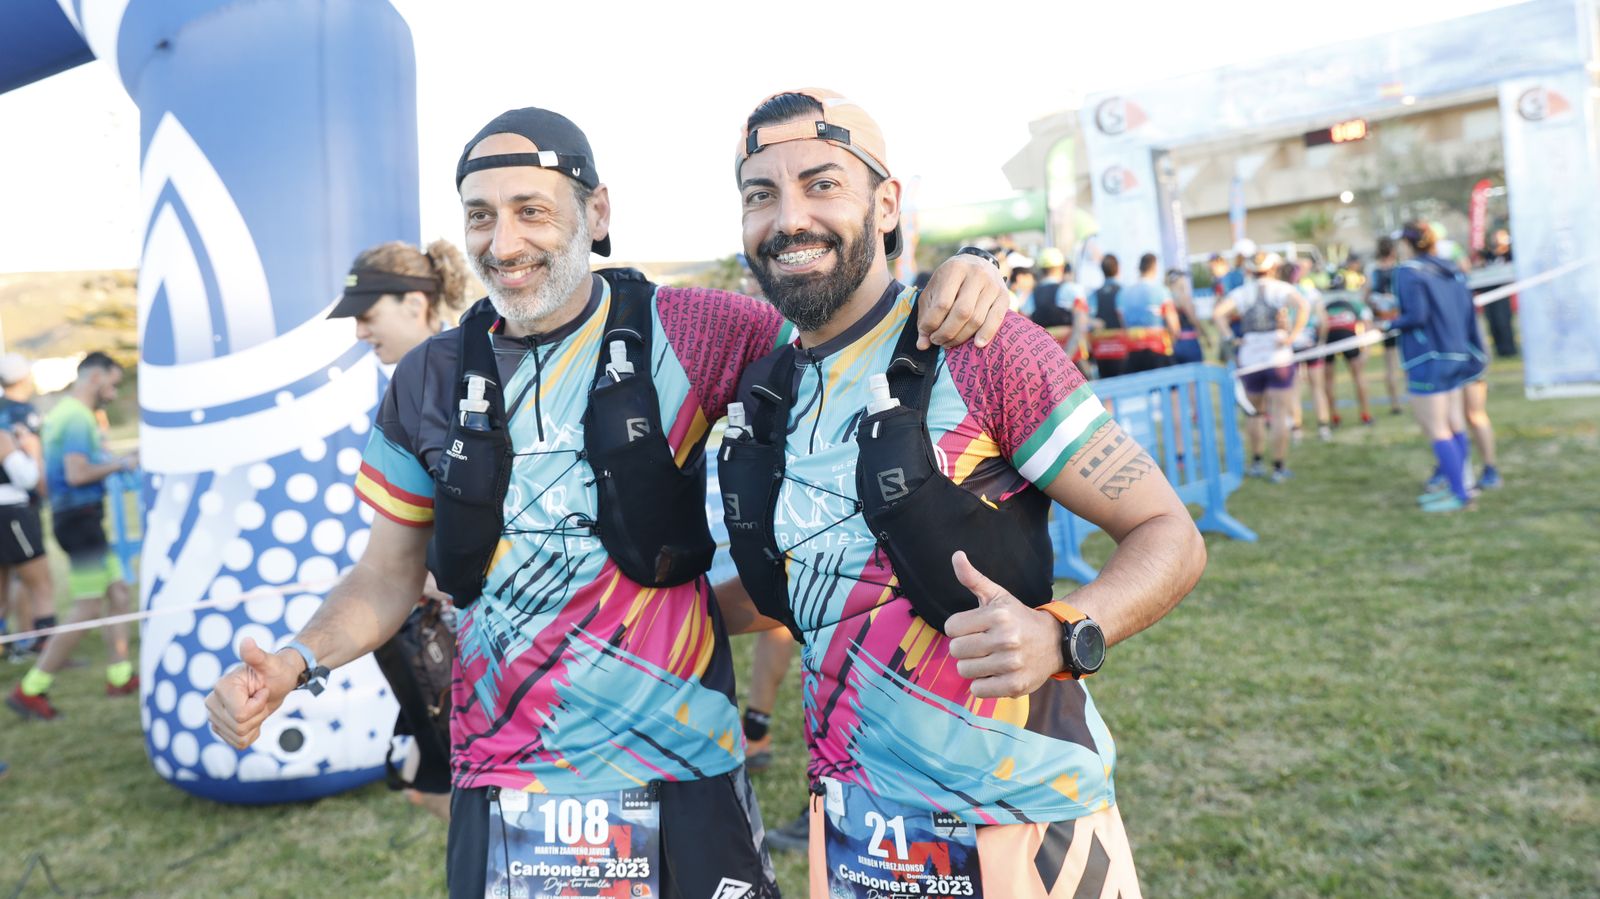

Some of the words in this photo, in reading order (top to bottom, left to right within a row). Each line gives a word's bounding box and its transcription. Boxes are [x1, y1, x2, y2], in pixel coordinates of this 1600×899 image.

[729, 314, 748, 371] AMISTAD
[1028, 366, 1056, 397] ALMA
[538, 798, 609, 845] 108
[864, 811, 909, 860] 21
[509, 861, 600, 877] Carbonera
[604, 862, 650, 878] 2023
[838, 863, 921, 894] Carbonera
[926, 879, 974, 896] 2023
